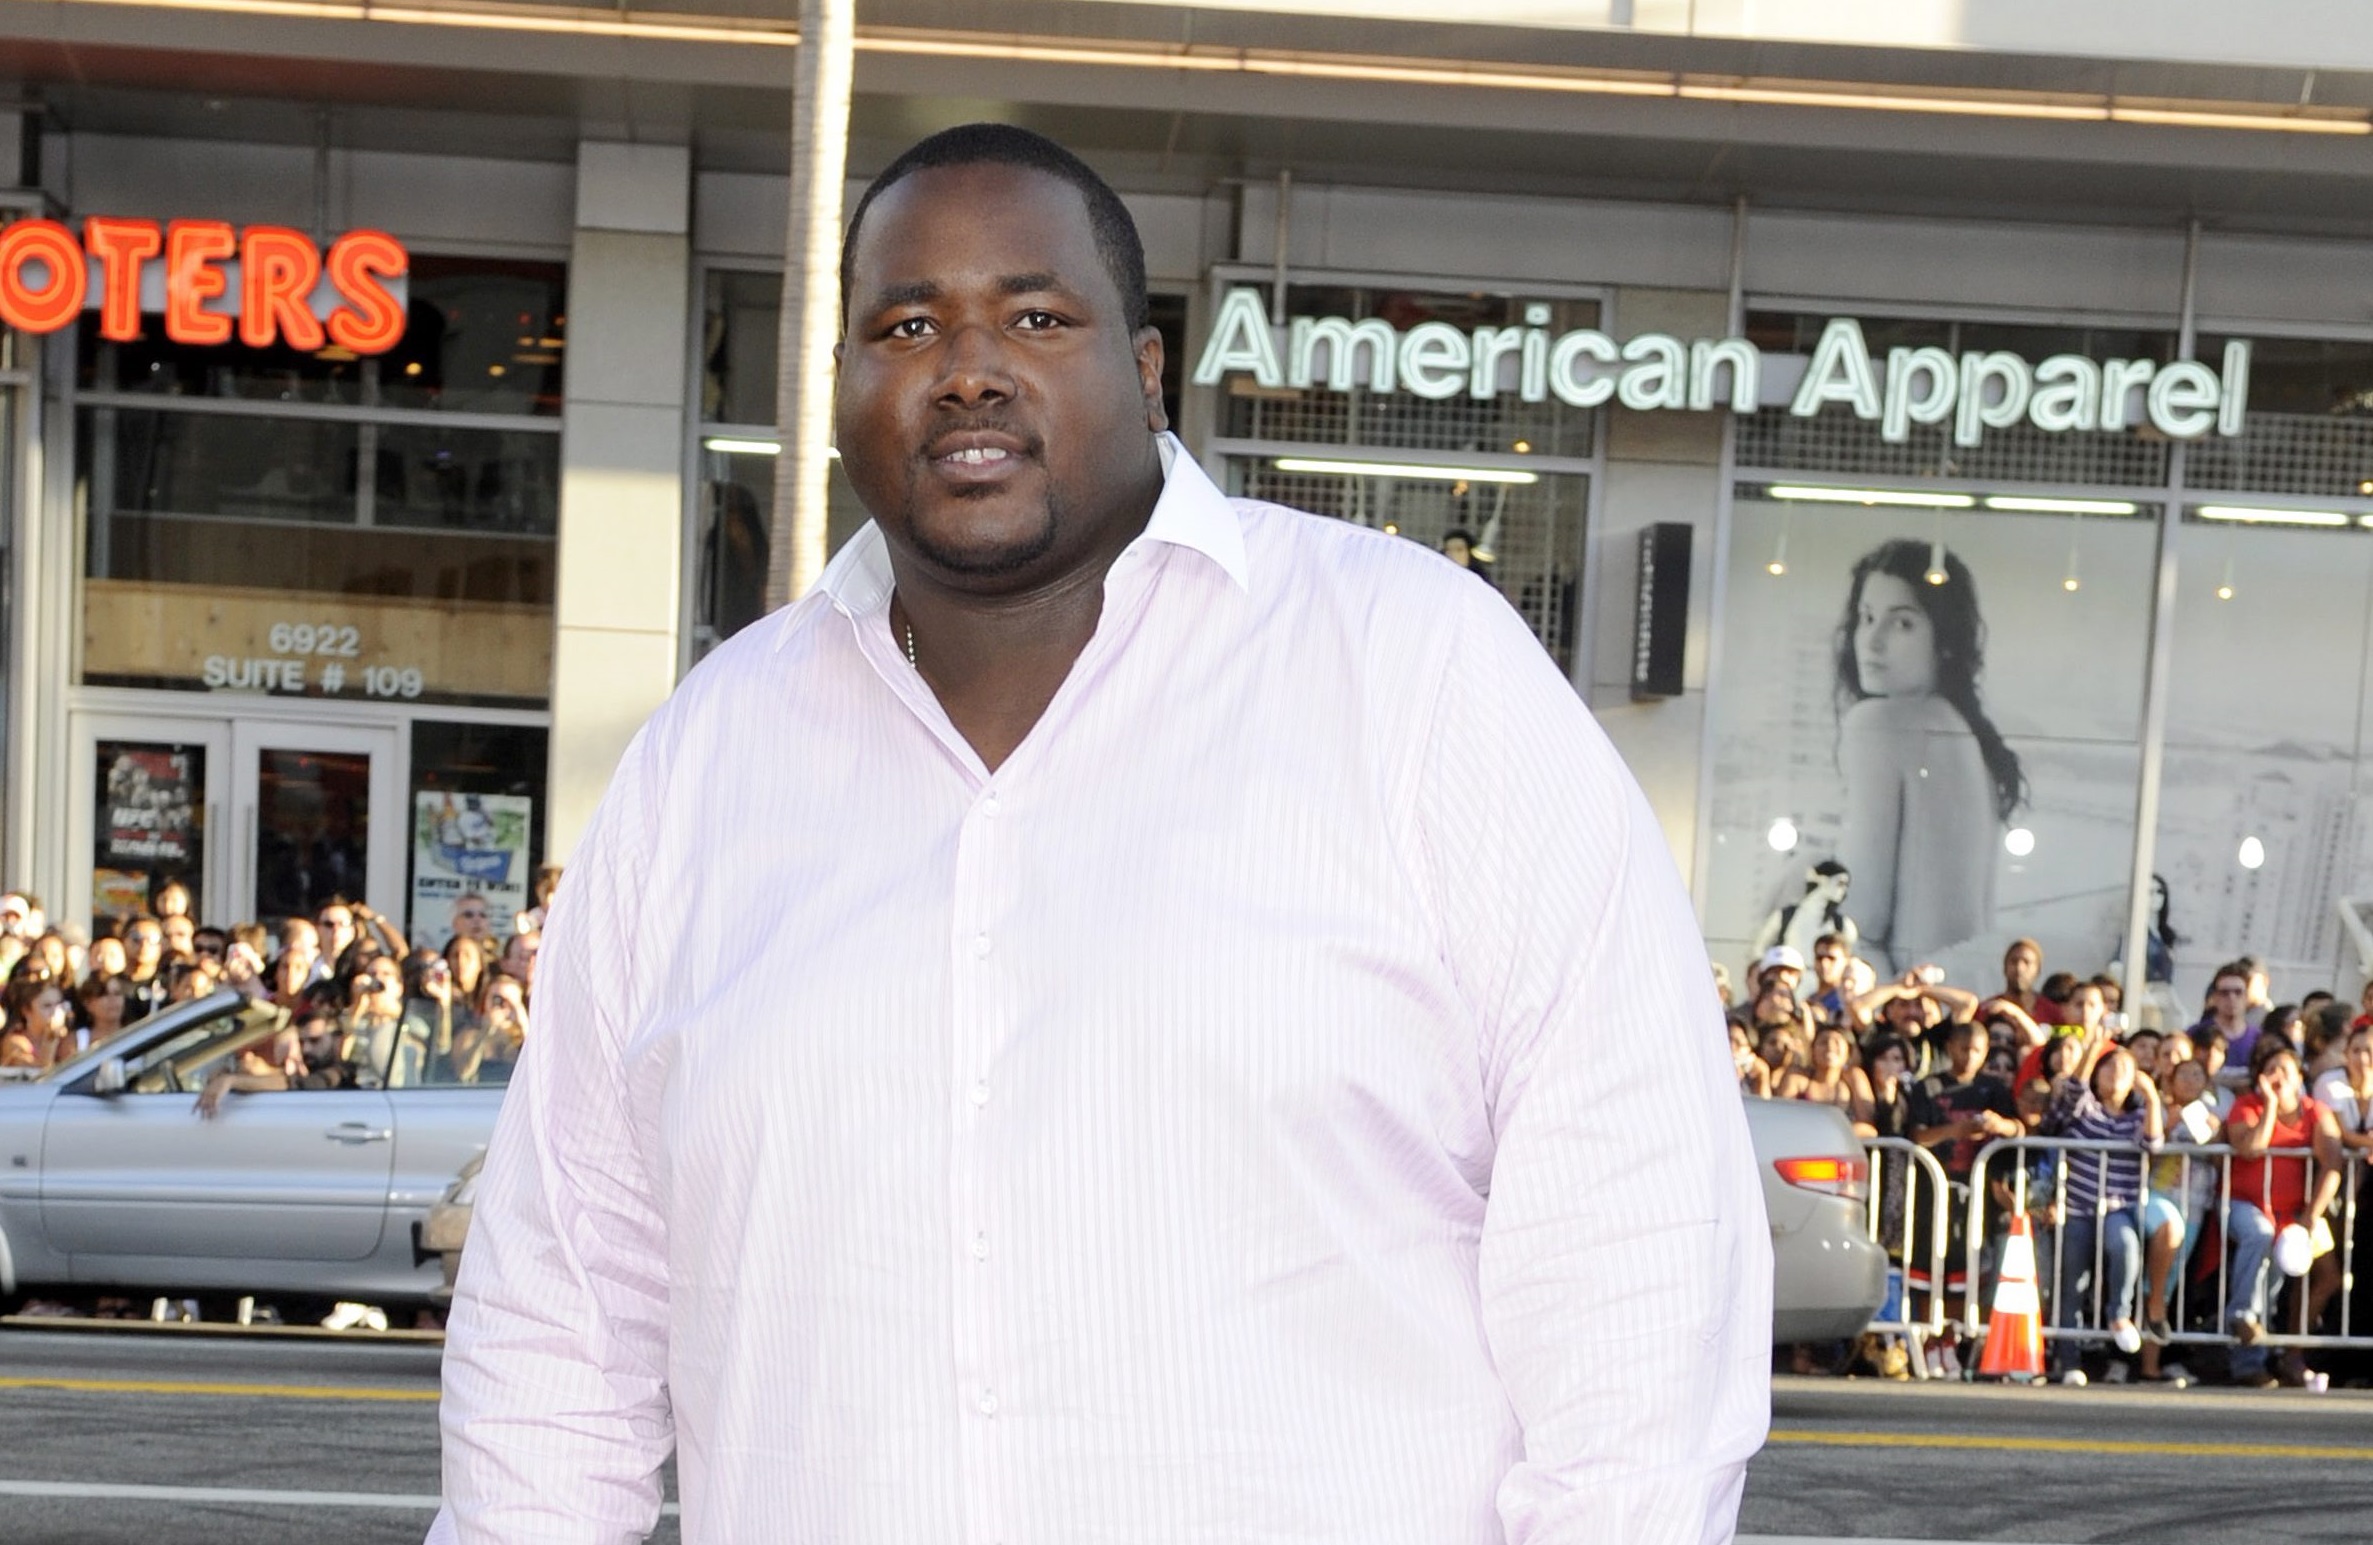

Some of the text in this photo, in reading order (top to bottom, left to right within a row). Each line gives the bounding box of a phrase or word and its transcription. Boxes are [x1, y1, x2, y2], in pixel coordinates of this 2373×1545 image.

[0, 215, 409, 354] OTERS
[1192, 287, 2251, 447] American Apparel
[202, 655, 423, 697] SUITE # 109
[269, 622, 360, 658] 6922
